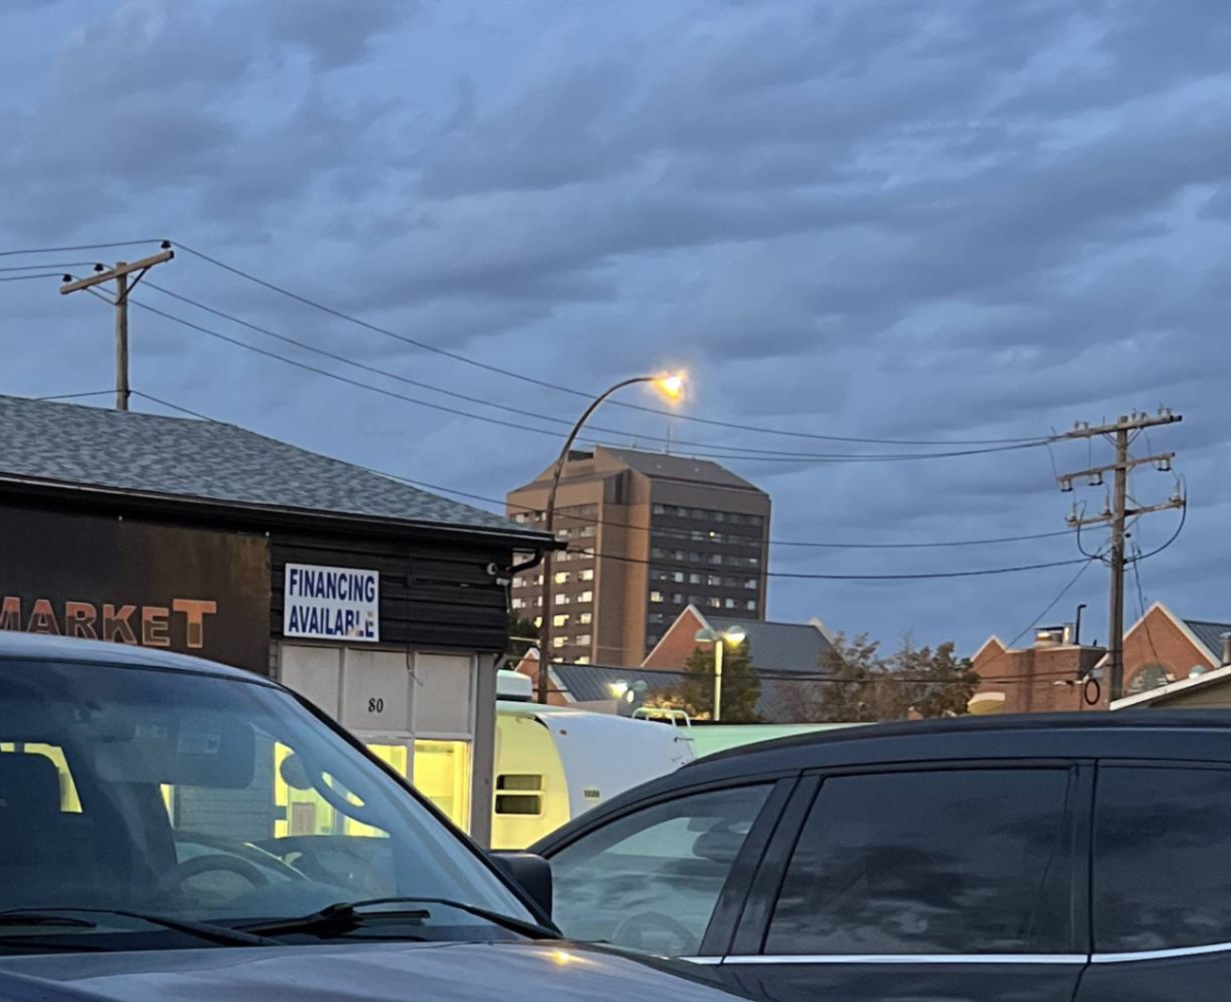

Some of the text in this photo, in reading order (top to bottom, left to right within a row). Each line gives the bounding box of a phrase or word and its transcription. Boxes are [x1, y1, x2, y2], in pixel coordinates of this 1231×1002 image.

[289, 568, 375, 603] FINANCING
[288, 605, 374, 638] AVAILABLE
[368, 698, 384, 713] 80
